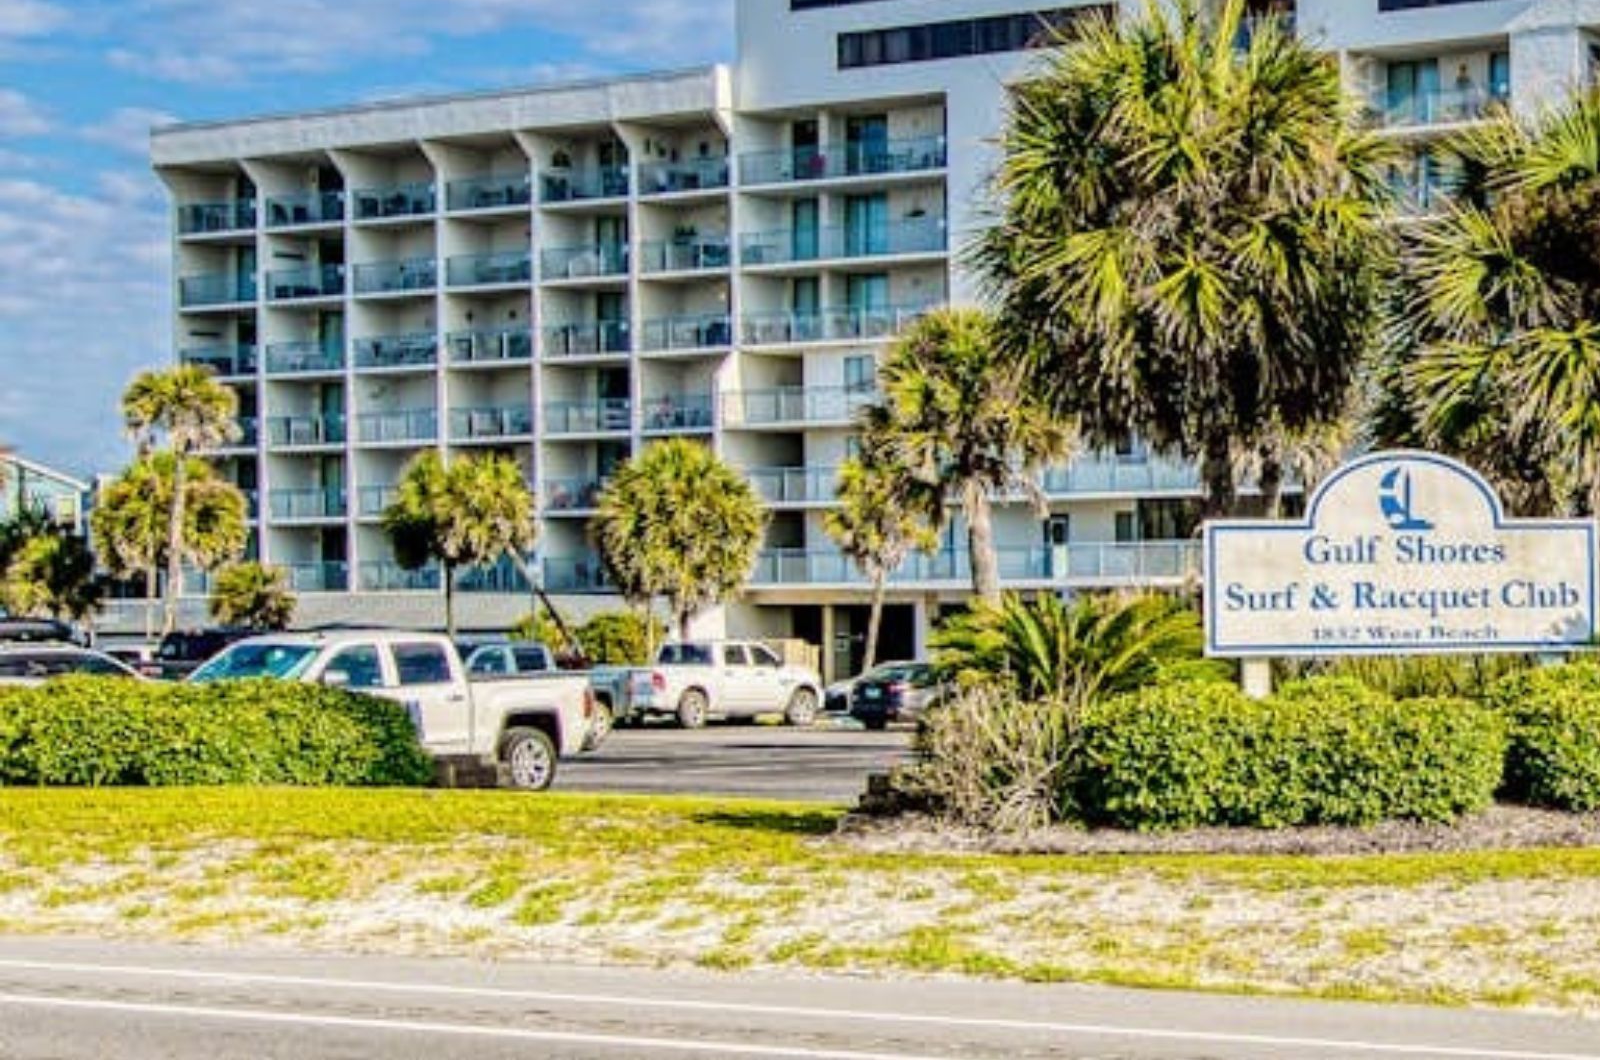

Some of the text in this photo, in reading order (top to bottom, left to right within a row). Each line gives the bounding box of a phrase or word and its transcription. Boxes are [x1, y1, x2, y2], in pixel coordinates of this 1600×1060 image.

[1304, 534, 1506, 564] Gulf Shores
[1226, 579, 1580, 618] Surf & Racquet Club
[1366, 626, 1422, 640] West
[1429, 623, 1499, 640] Beach
